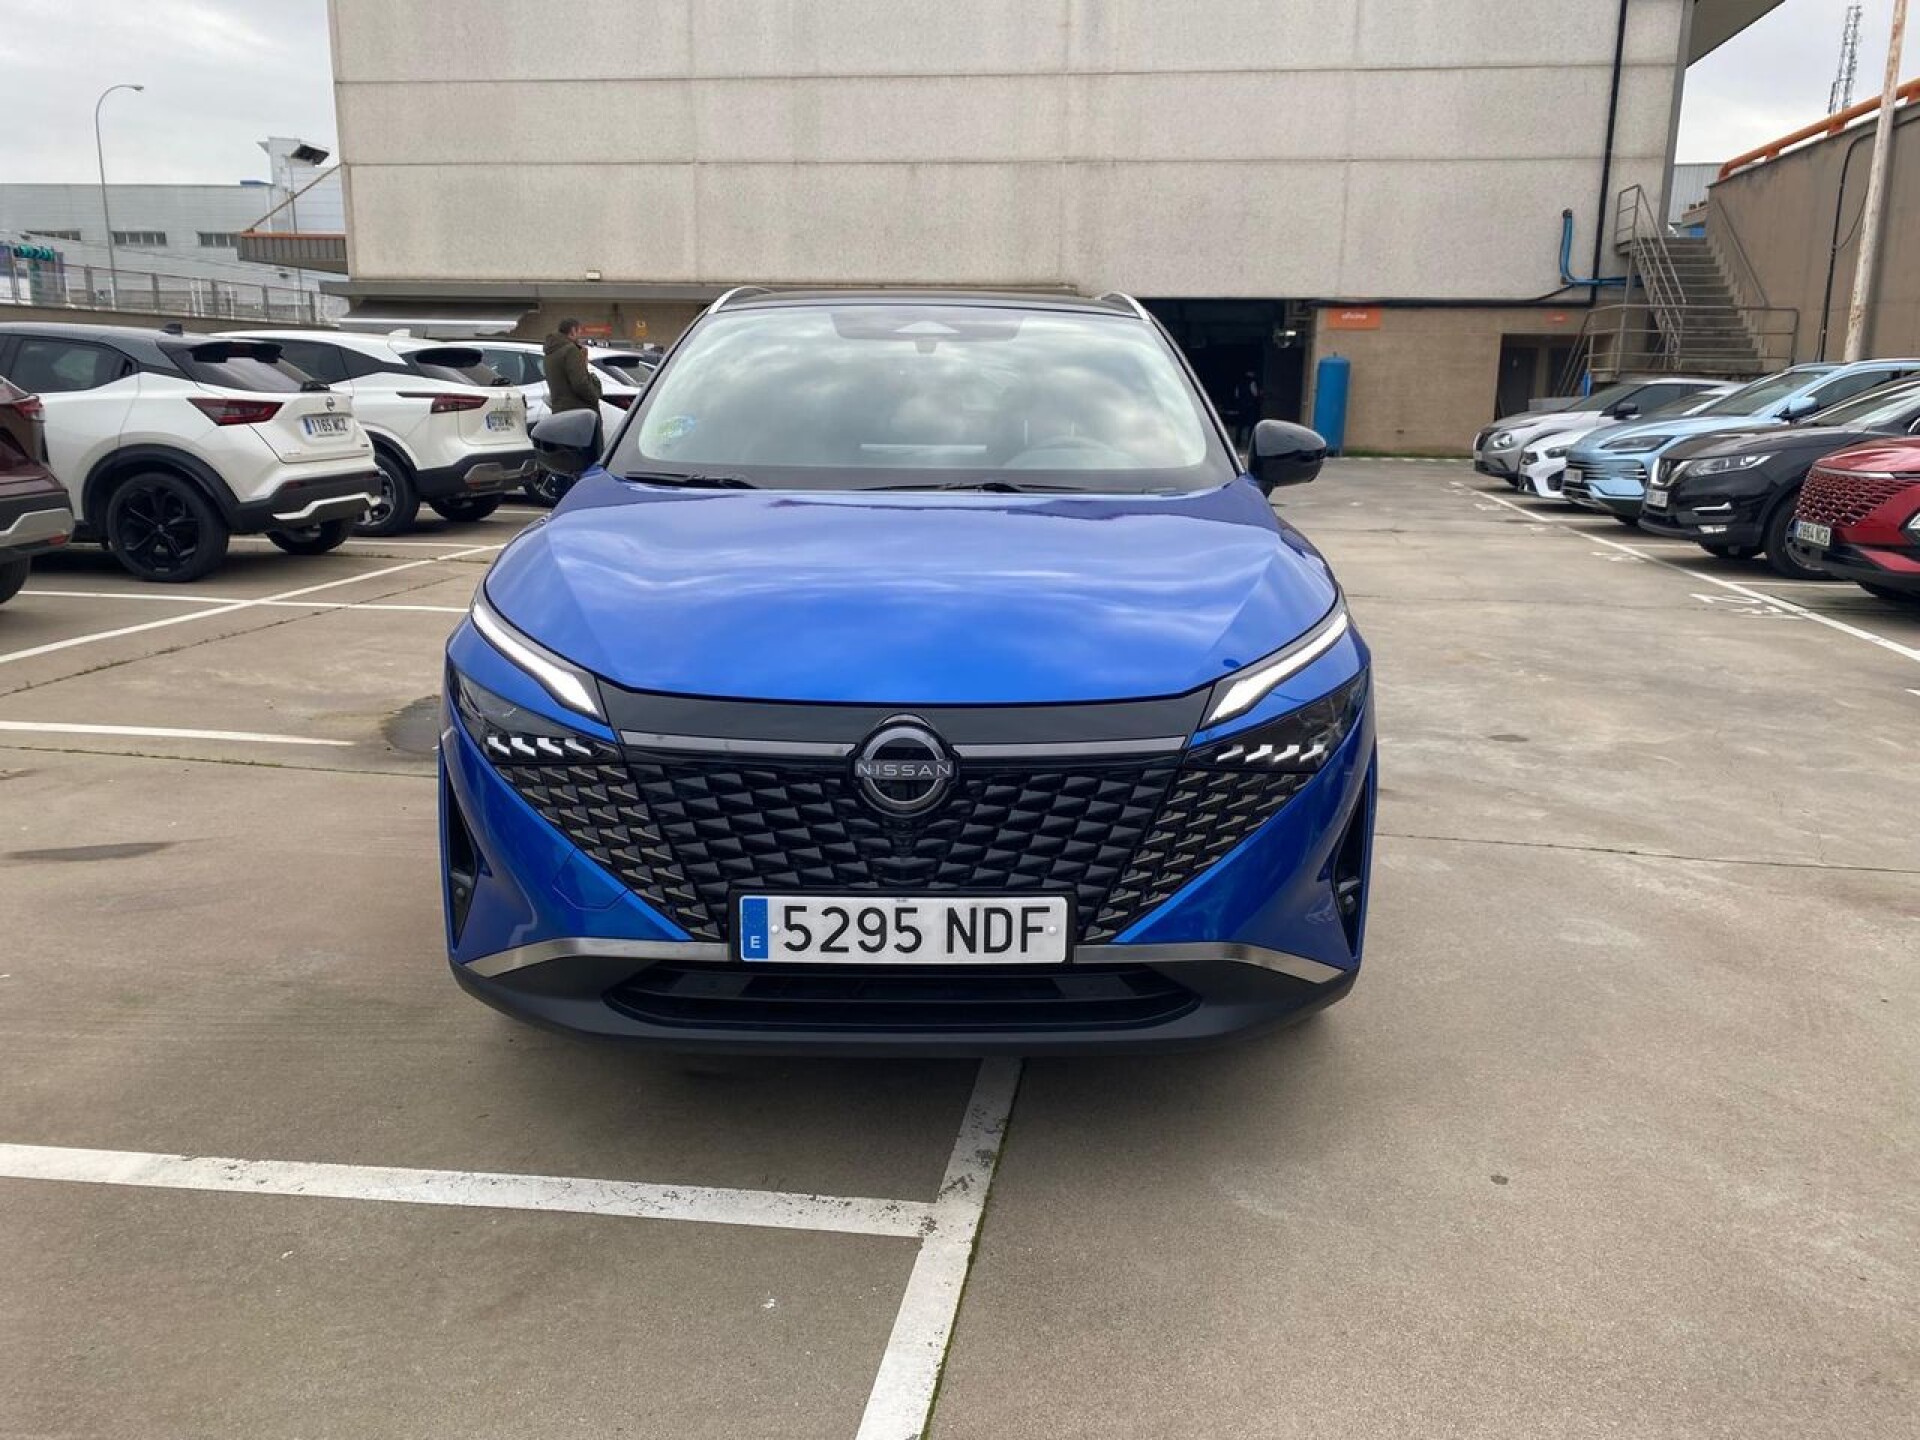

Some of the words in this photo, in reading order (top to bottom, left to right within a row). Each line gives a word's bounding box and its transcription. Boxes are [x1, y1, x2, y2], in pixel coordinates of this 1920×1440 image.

[857, 762, 951, 777] NISSAN
[783, 905, 922, 953] 5295
[946, 906, 1050, 954] NDF
[750, 935, 760, 949] E
